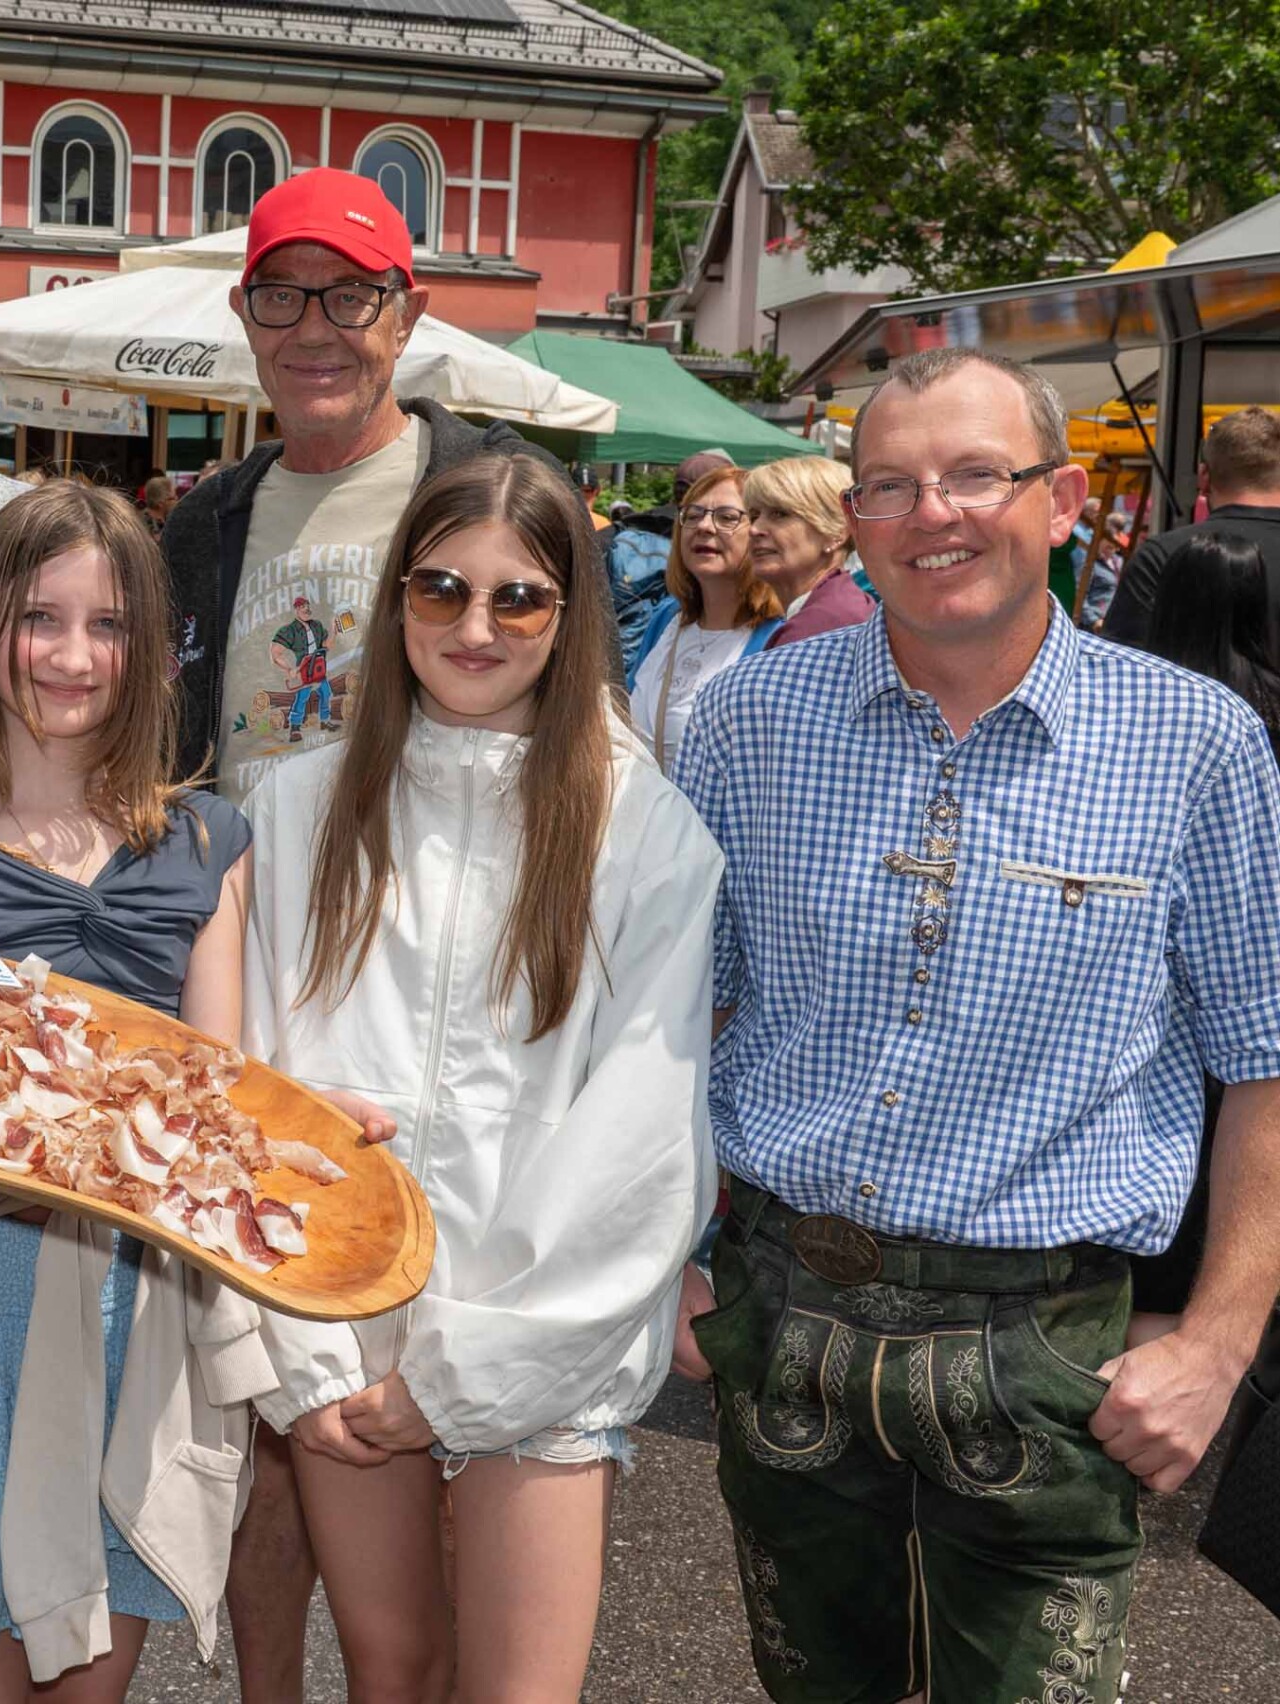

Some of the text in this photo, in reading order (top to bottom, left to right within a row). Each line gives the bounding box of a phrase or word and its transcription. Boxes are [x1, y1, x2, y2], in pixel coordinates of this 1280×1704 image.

[115, 338, 224, 378] Coca-Cola
[309, 543, 380, 582] KERL
[234, 577, 372, 644] MACHEN HOL
